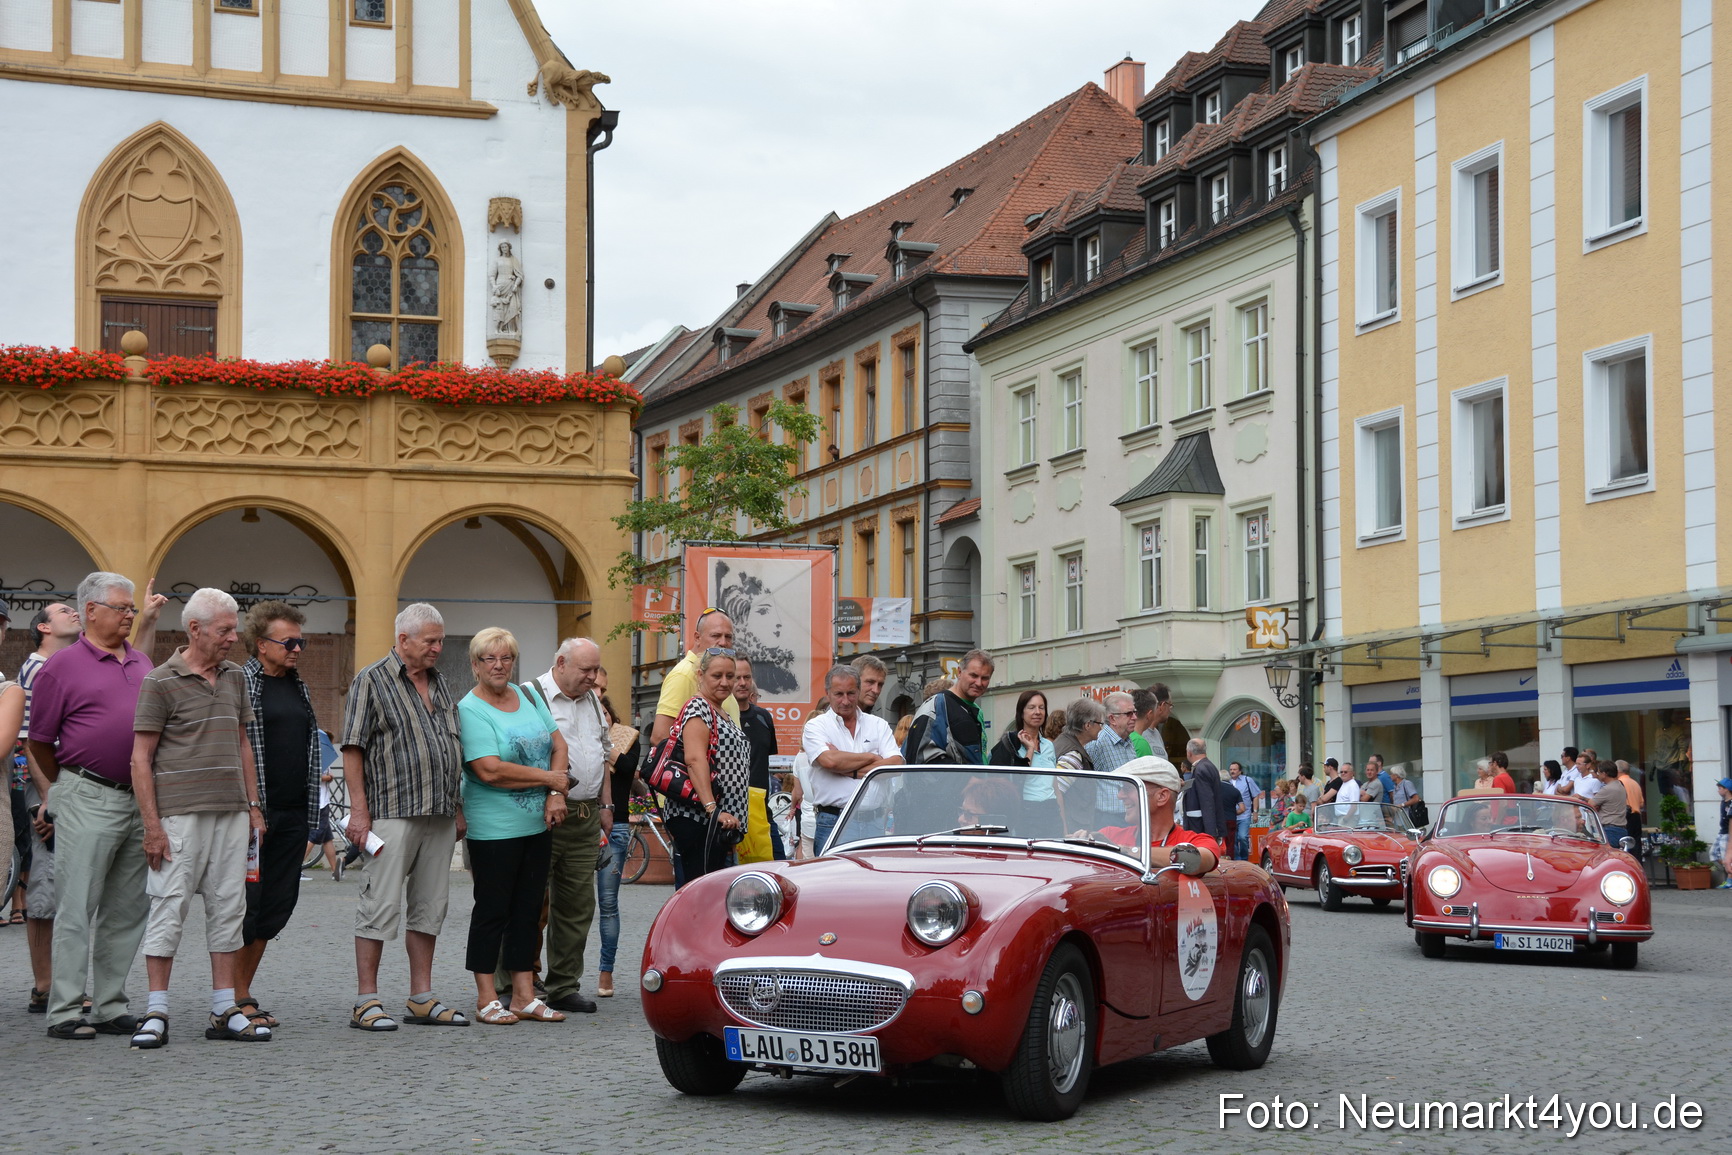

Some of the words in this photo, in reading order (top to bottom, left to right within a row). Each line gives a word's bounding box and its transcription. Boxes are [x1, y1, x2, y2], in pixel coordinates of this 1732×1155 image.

[837, 625, 856, 634] 2014
[1262, 619, 1280, 636] M
[1187, 881, 1200, 898] 14
[1502, 936, 1510, 948] N
[1518, 936, 1532, 949] SI
[1536, 937, 1573, 950] 1402H
[731, 1047, 737, 1055] D
[740, 1033, 784, 1061] LAU
[800, 1038, 829, 1064] BJ
[833, 1040, 877, 1068] 58H
